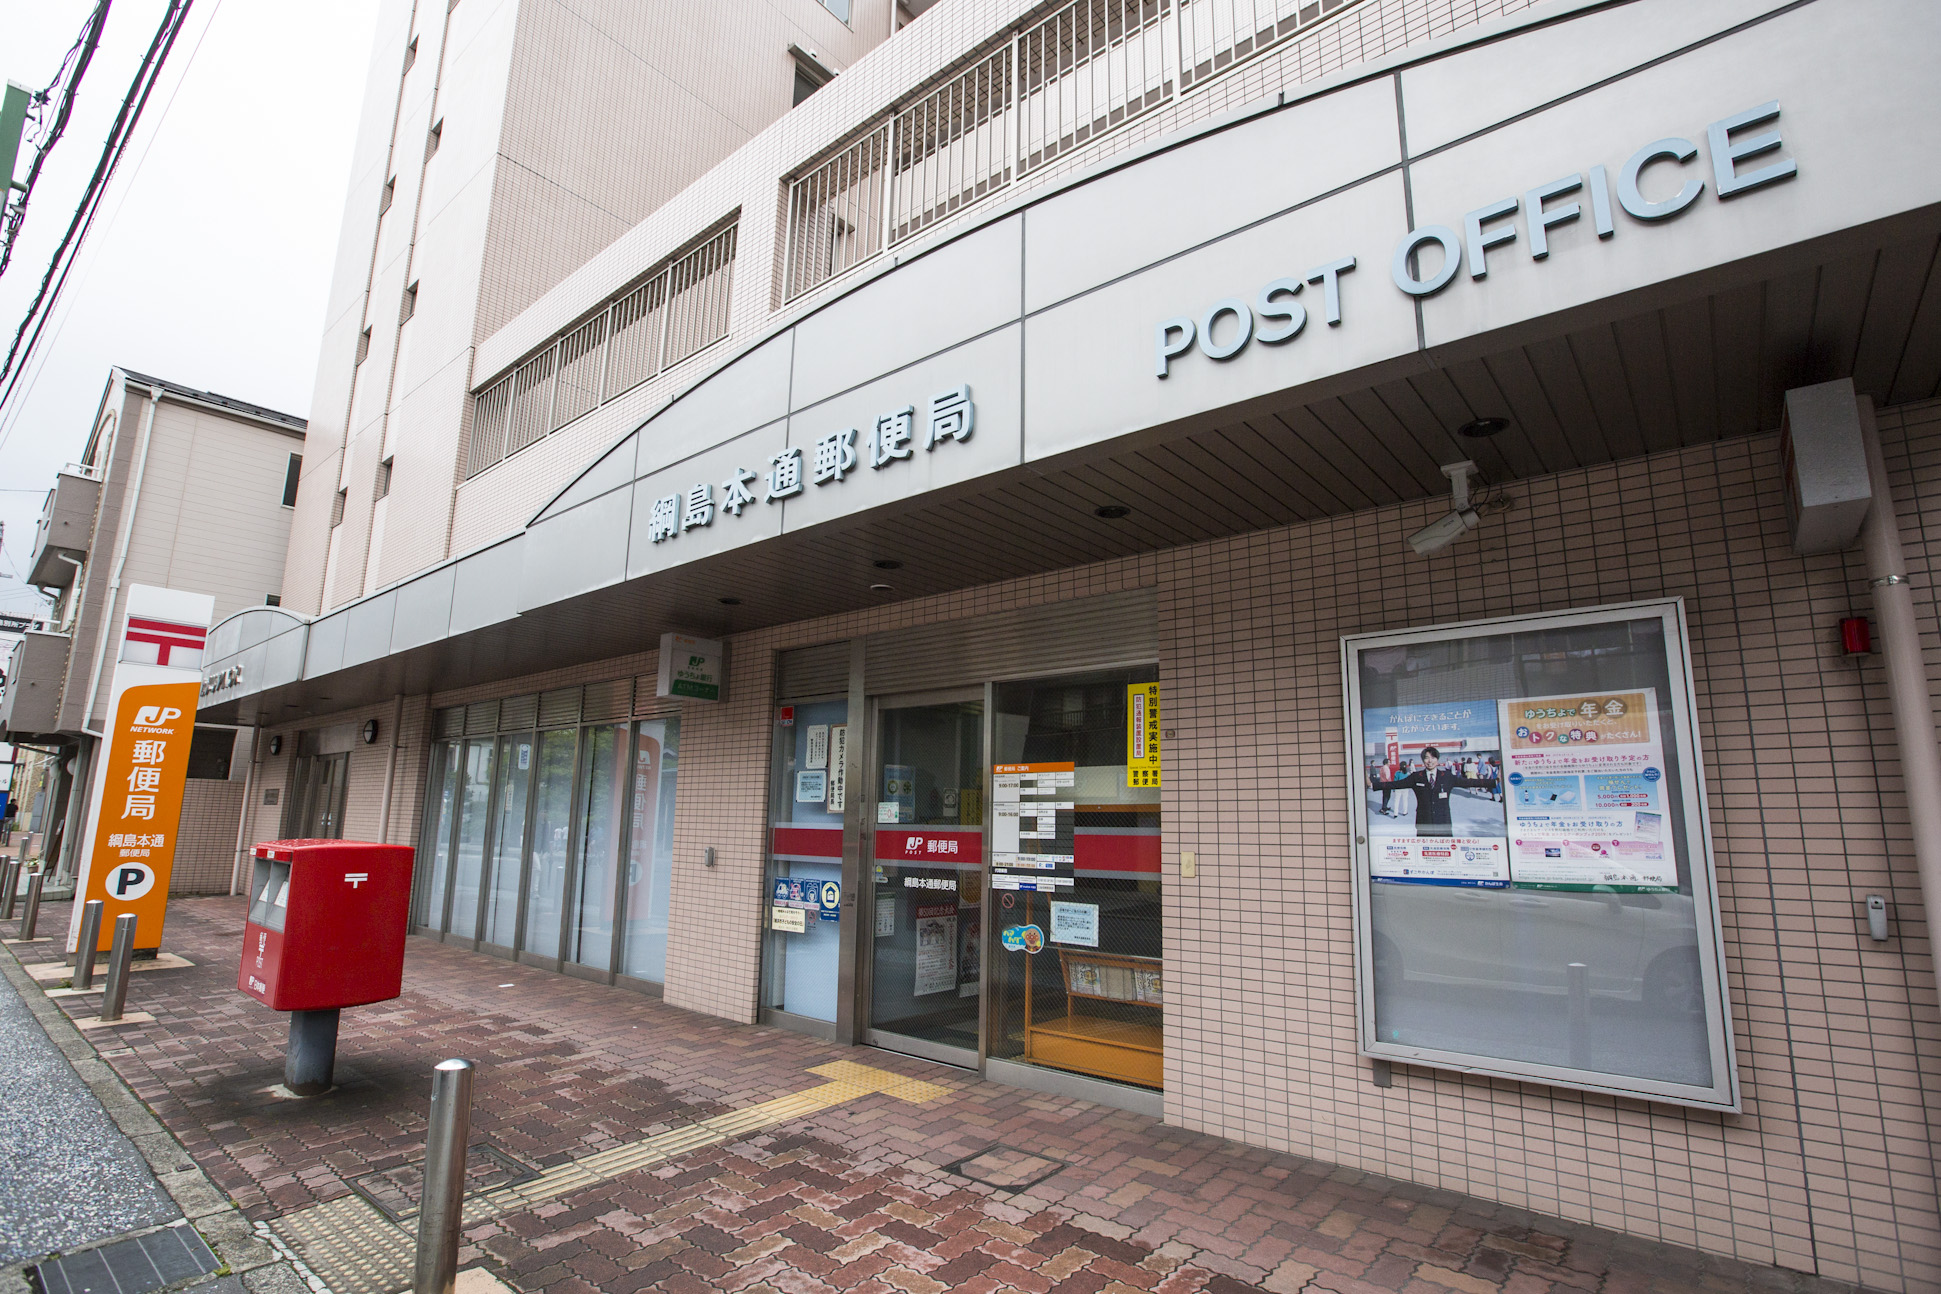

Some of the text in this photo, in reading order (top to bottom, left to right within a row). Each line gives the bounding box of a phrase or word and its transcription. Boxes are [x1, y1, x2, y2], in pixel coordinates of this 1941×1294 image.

[1154, 99, 1798, 380] POST OFFICE
[648, 382, 976, 544] 綱島本通郵便局
[677, 670, 713, 683] ゆうちょ銀行
[1389, 708, 1472, 724] かんぽにできることが
[1524, 699, 1624, 720] ゆうちょで年金
[130, 725, 175, 735] NETWORK
[1148, 685, 1158, 766] 特別警戒実施中
[1401, 723, 1461, 735] 広がっています。
[1514, 754, 1650, 767] 新たにゆうちょで年金をお受け取り予定の方
[836, 729, 846, 809] 防犯カメラ作動中です
[120, 739, 167, 821] 郵便局
[1519, 820, 1624, 828] ゆうちょで年金をお受け取りの方
[107, 833, 165, 848] 綱島本通
[926, 839, 959, 855] 郵便局
[118, 848, 151, 858] 郵便局
[116, 867, 146, 896] P
[903, 876, 957, 892] 綱島本通郵便局
